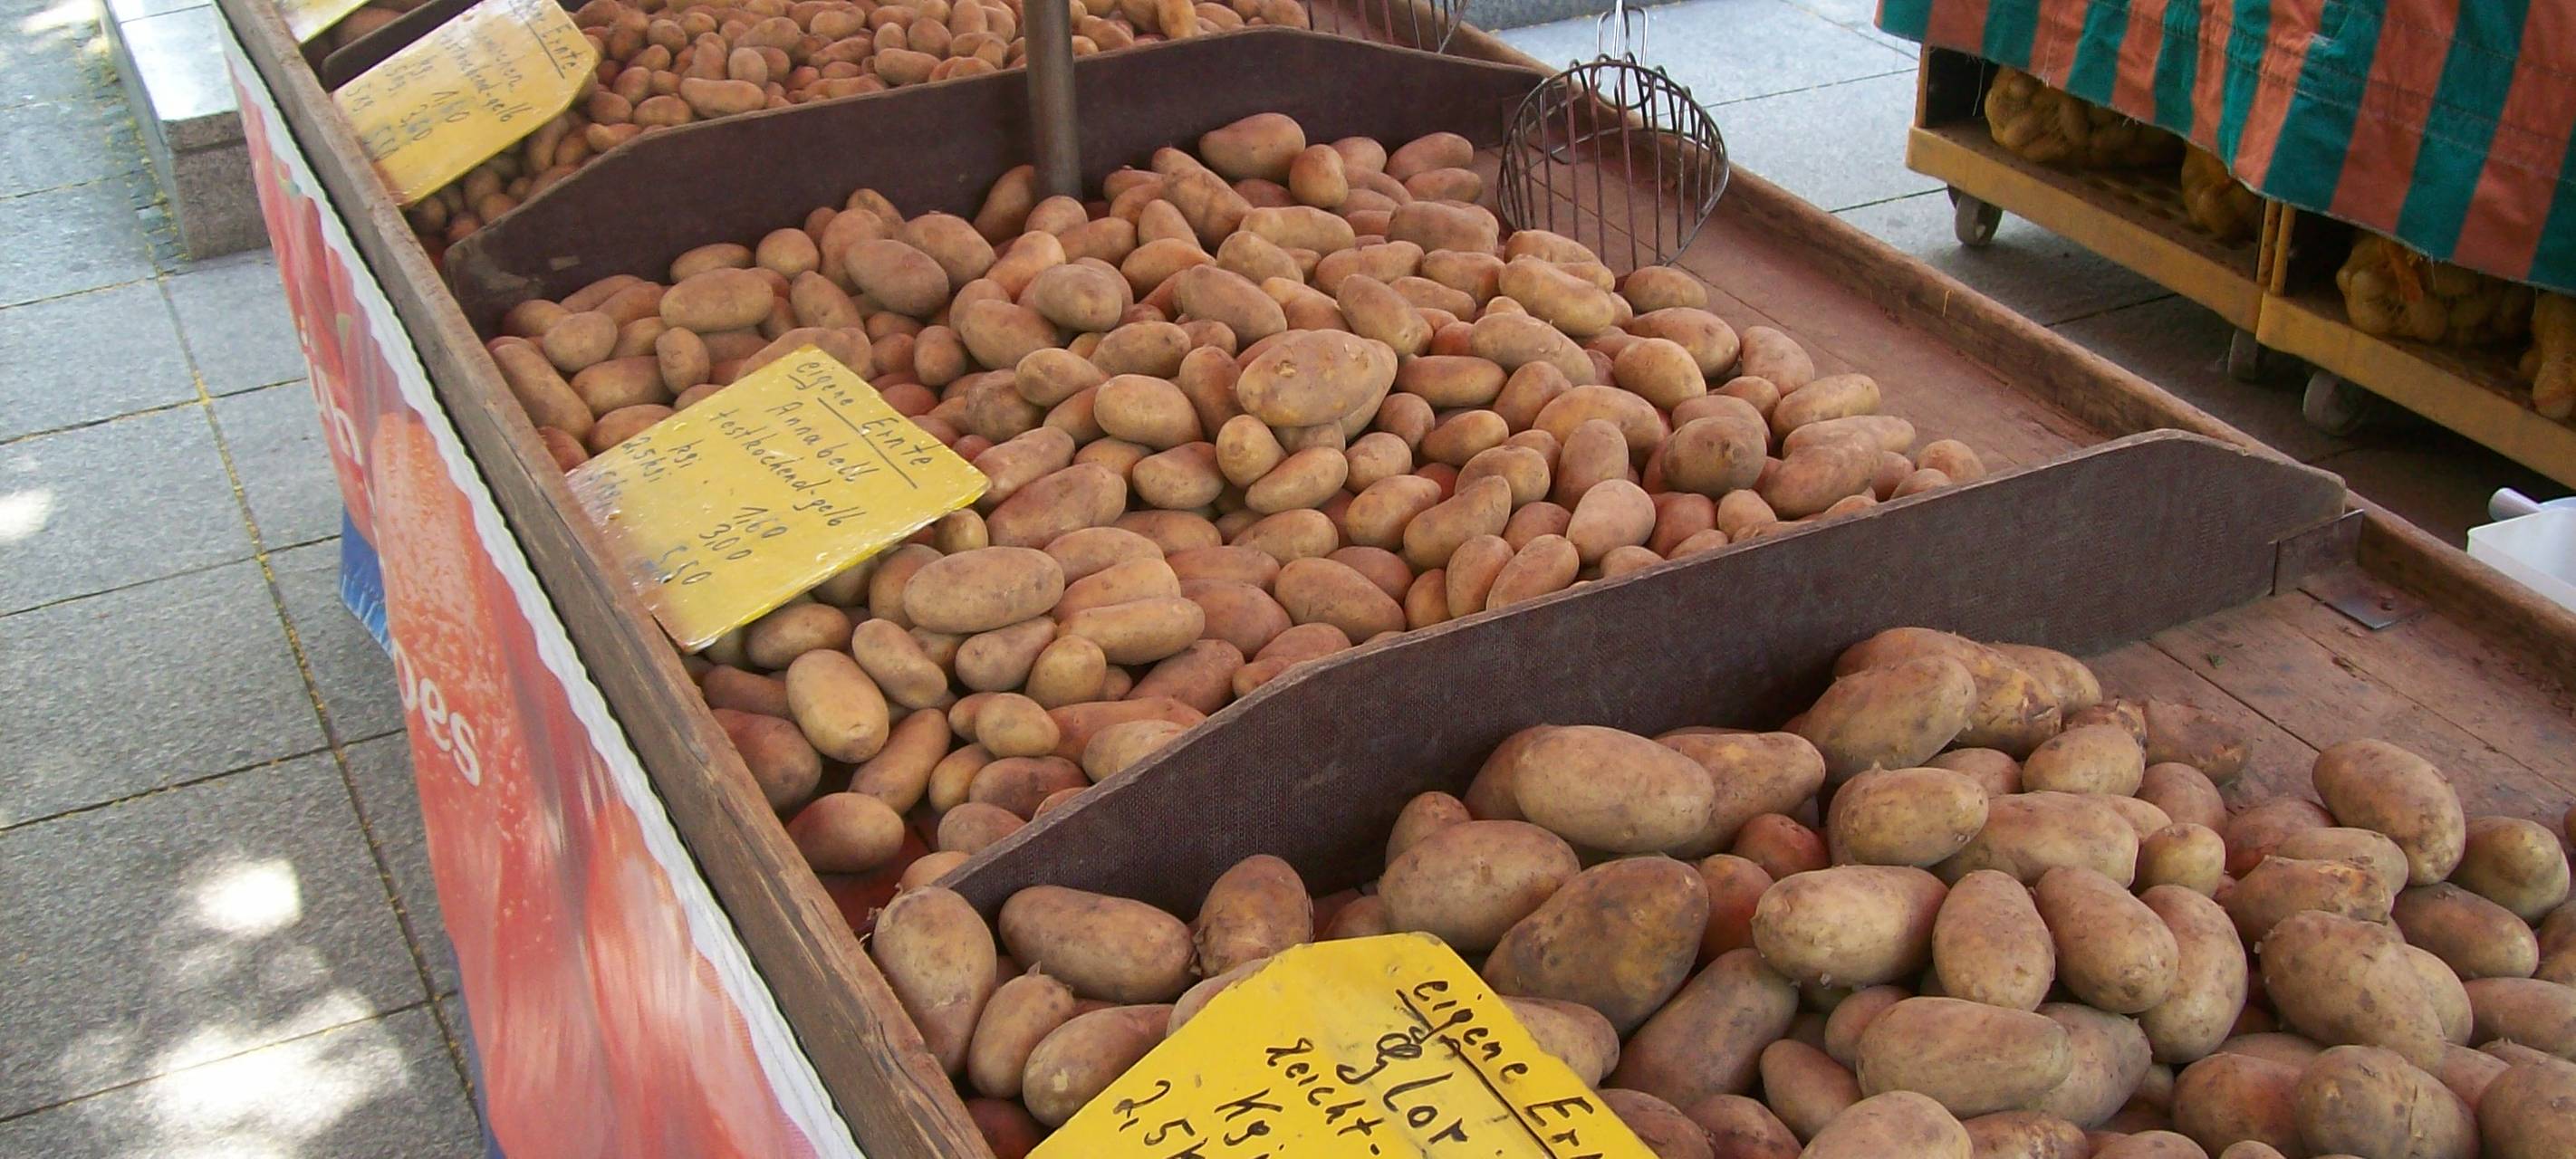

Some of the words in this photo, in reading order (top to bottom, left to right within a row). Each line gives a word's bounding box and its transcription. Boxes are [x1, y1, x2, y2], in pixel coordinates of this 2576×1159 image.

[764, 401, 879, 482] Annabell
[795, 361, 854, 406] eigene
[861, 417, 943, 465] Ernte
[698, 523, 753, 560] 3,00
[1335, 1030, 1504, 1155] Glor
[1408, 981, 1529, 1085] eigene
[1523, 1096, 1604, 1159] Er
